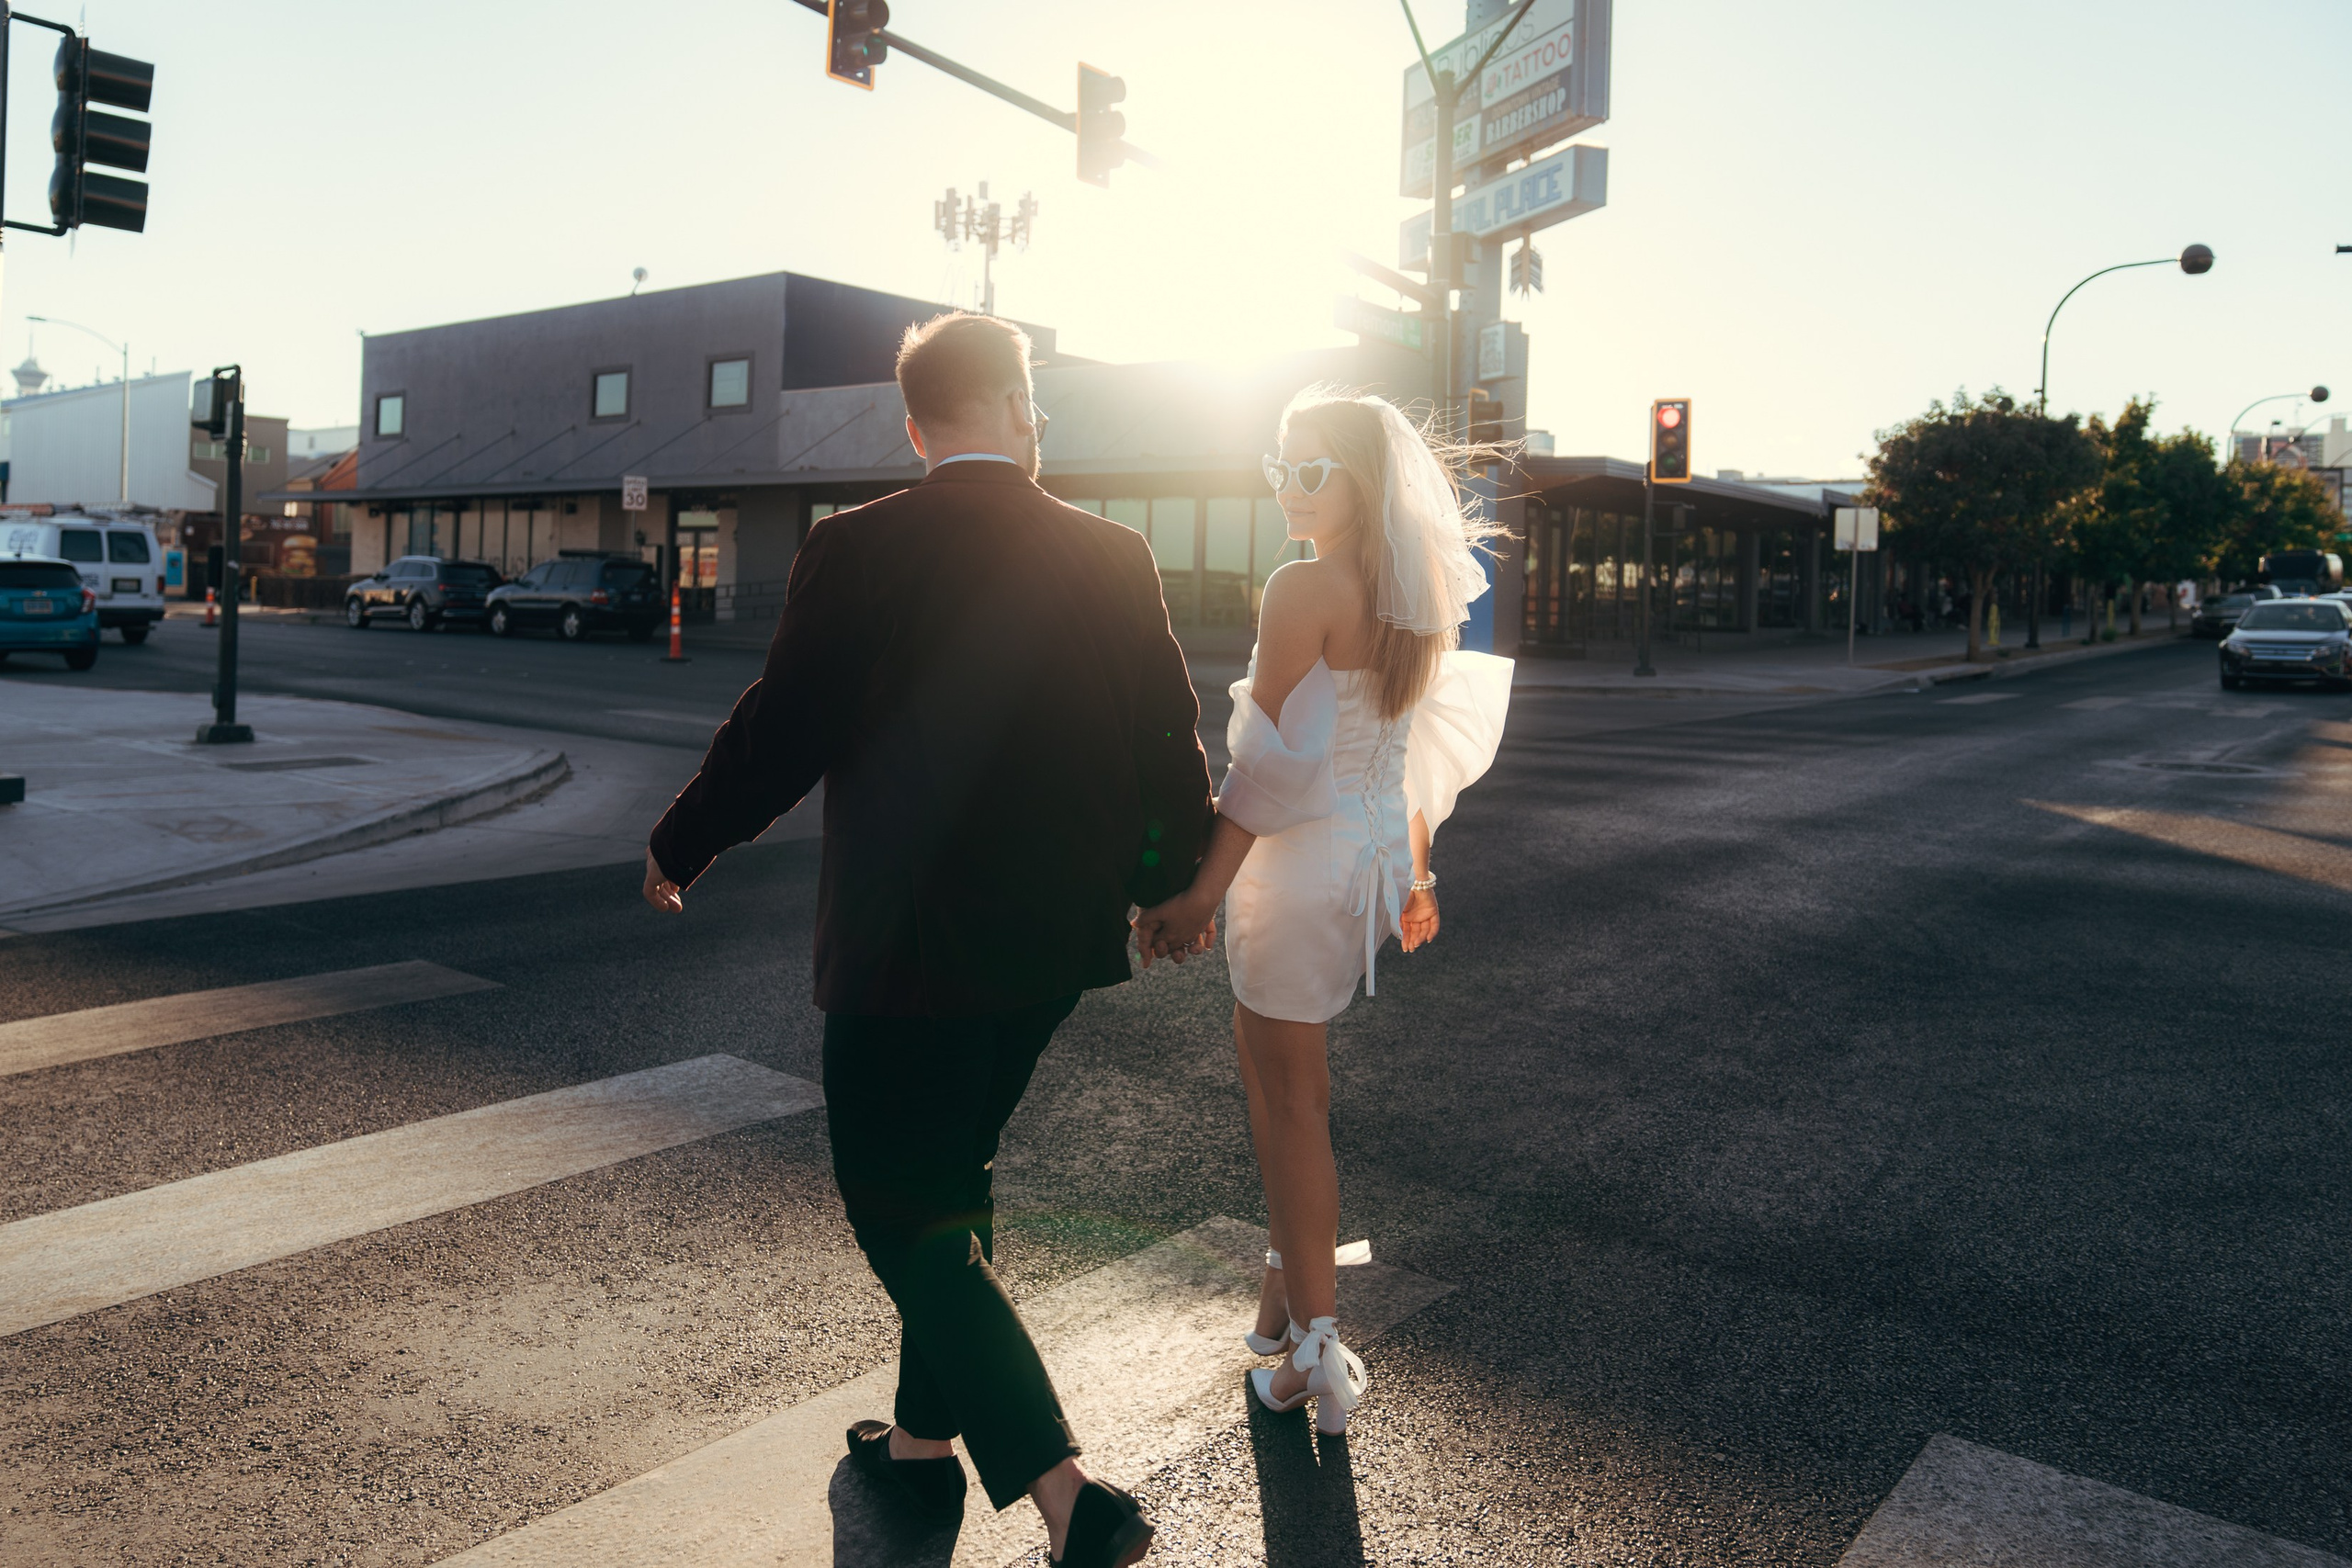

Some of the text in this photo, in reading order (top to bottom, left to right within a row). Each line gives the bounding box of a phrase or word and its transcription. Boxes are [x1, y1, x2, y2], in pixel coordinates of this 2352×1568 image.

[1502, 32, 1572, 88] TATTOO
[1486, 86, 1566, 145] BARBERSHOP
[1493, 162, 1564, 224] PLACE
[626, 492, 645, 506] 30
